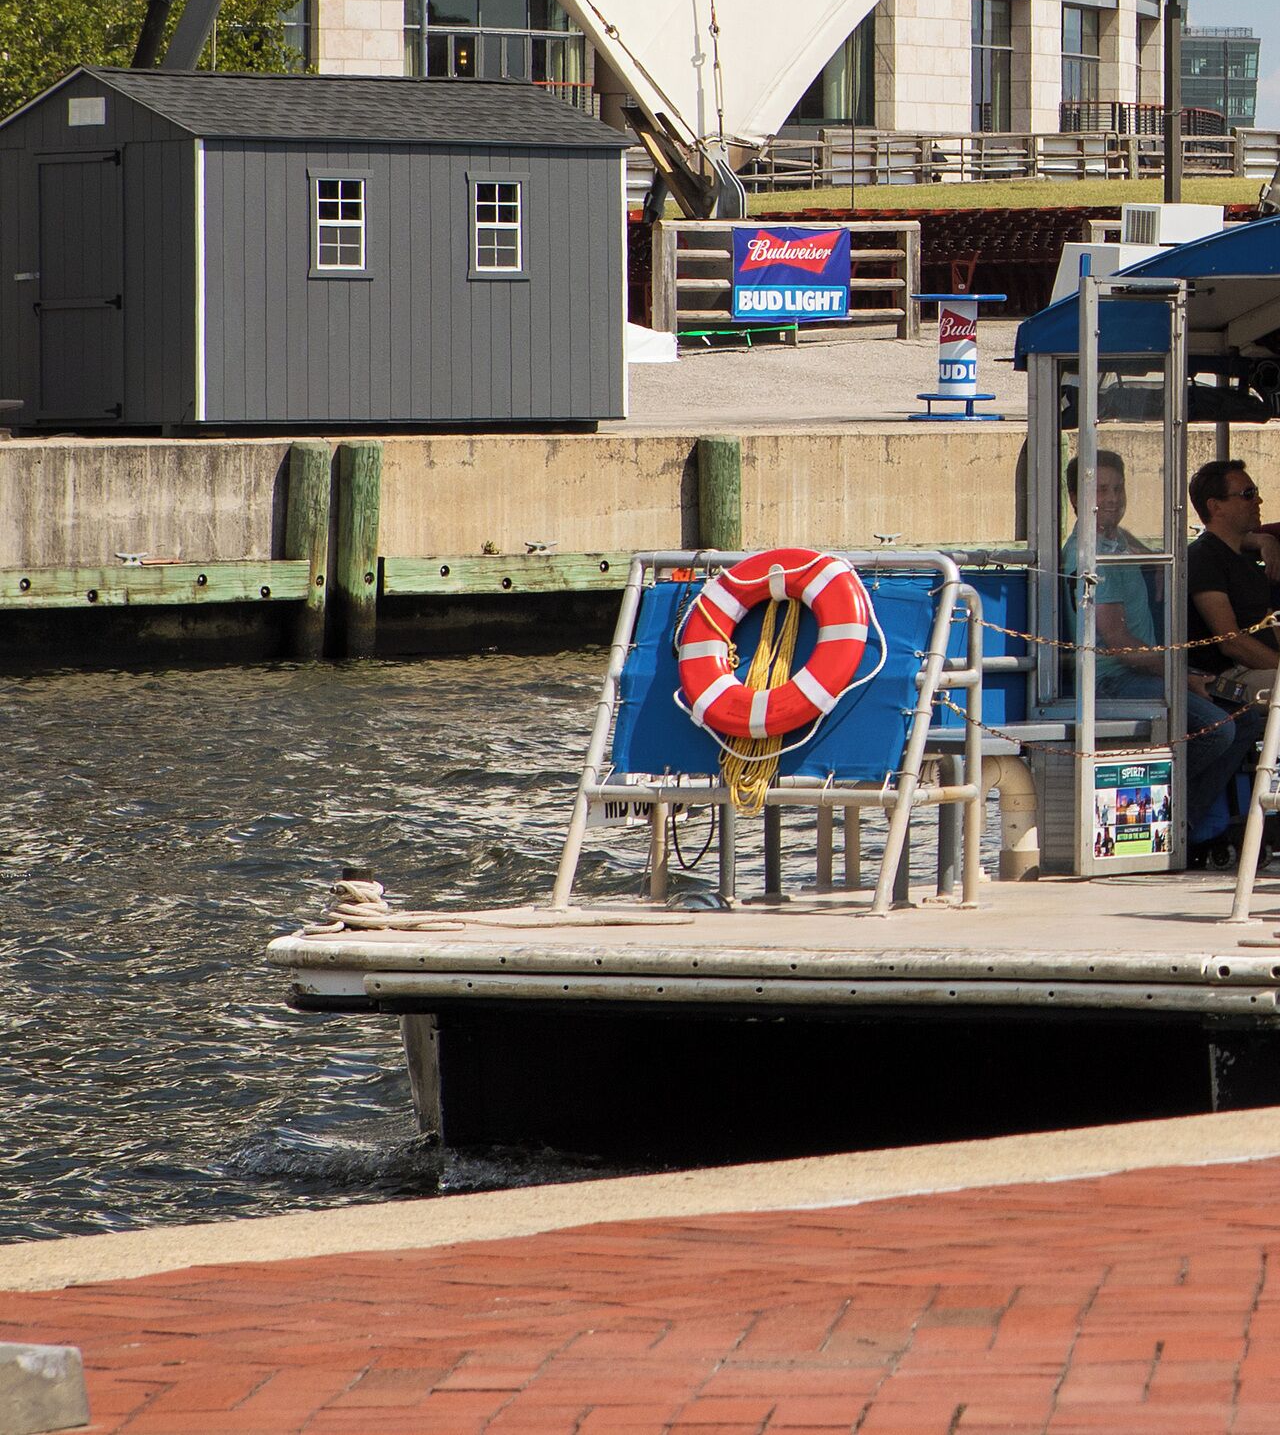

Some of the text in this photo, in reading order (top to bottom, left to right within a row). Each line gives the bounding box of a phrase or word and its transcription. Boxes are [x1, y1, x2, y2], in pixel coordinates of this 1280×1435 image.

[747, 239, 833, 262] Budweiser
[738, 290, 842, 312] BUD LIGHT
[1121, 766, 1146, 778] SPIRIT
